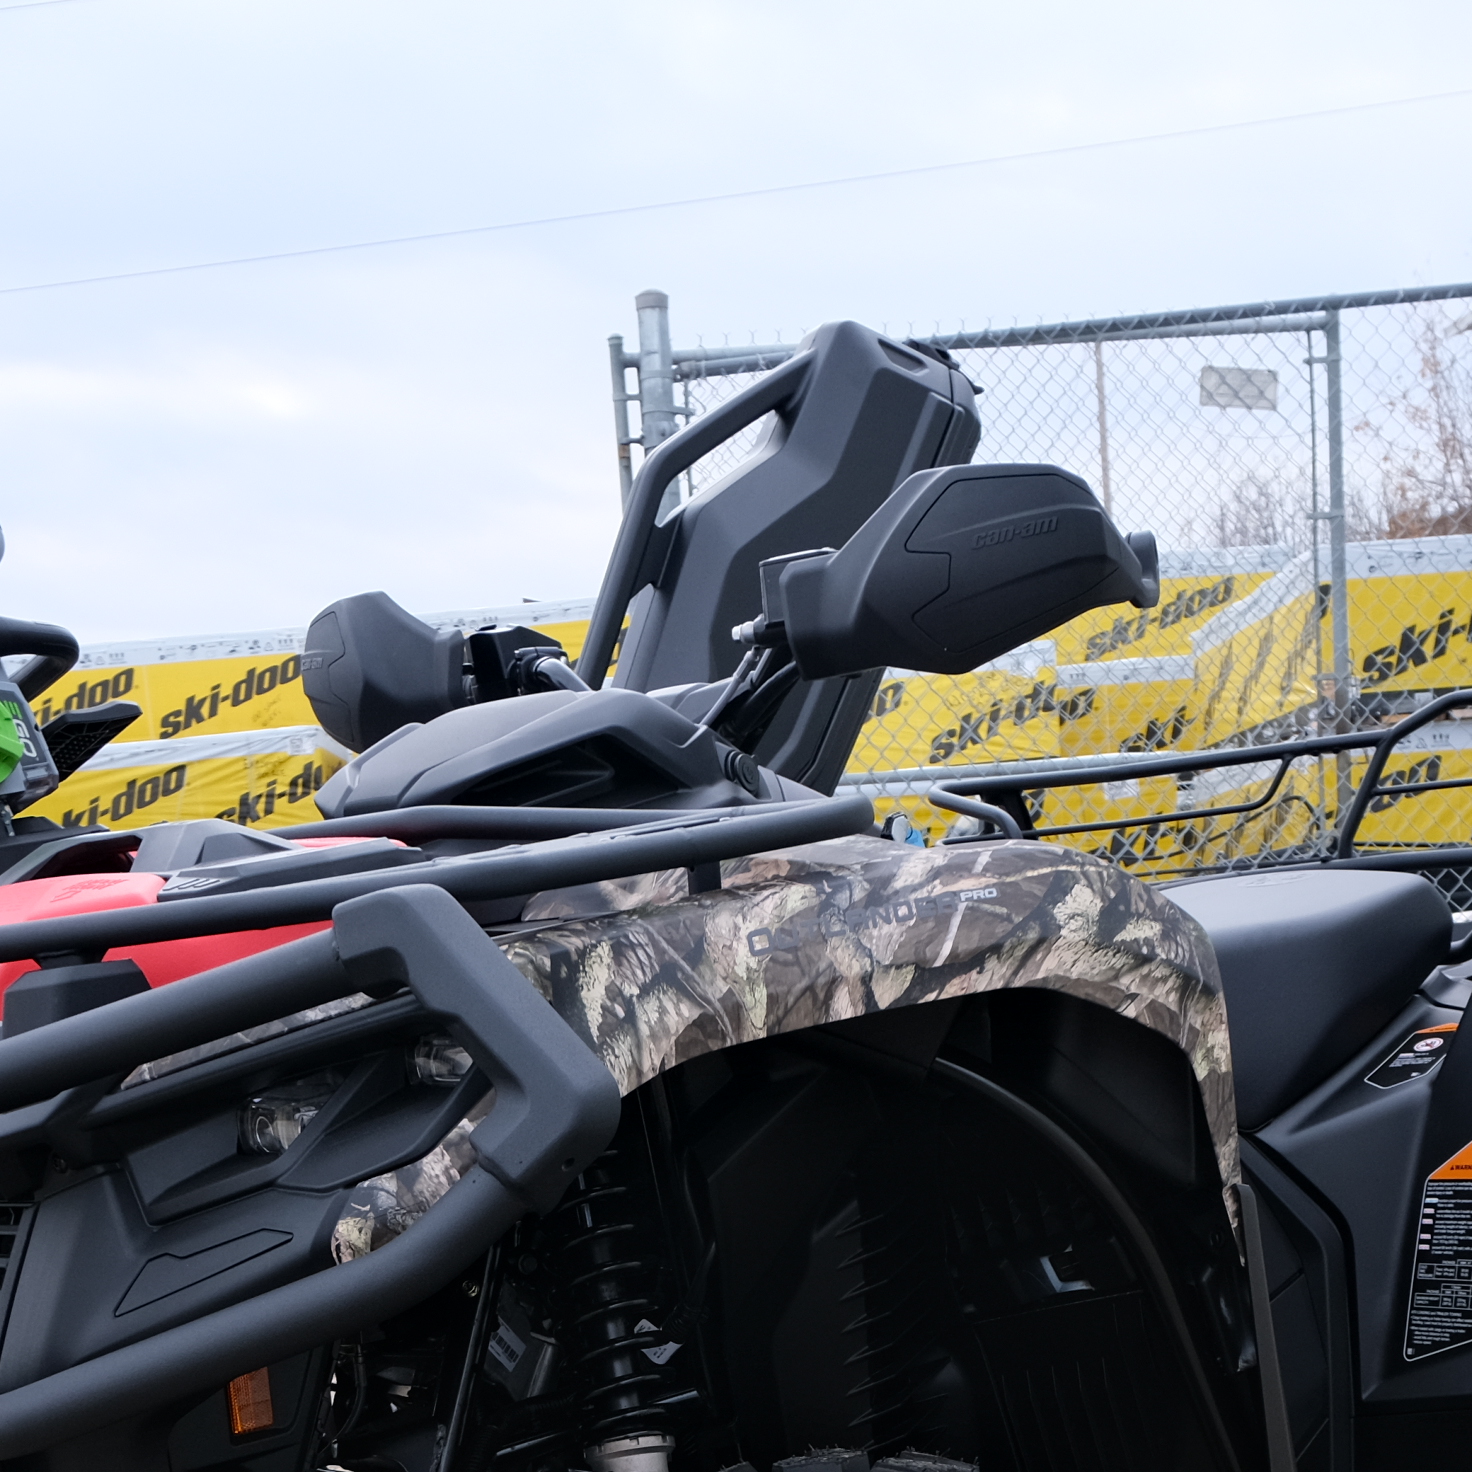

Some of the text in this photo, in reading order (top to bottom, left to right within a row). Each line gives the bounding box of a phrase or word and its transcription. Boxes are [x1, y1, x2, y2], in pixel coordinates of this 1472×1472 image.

[971, 515, 1059, 550] can-am
[1085, 576, 1235, 662] ski-doo
[160, 654, 302, 740] ski-doo
[62, 764, 186, 828] ki-doo
[746, 887, 999, 957] OUTLANDER PRO
